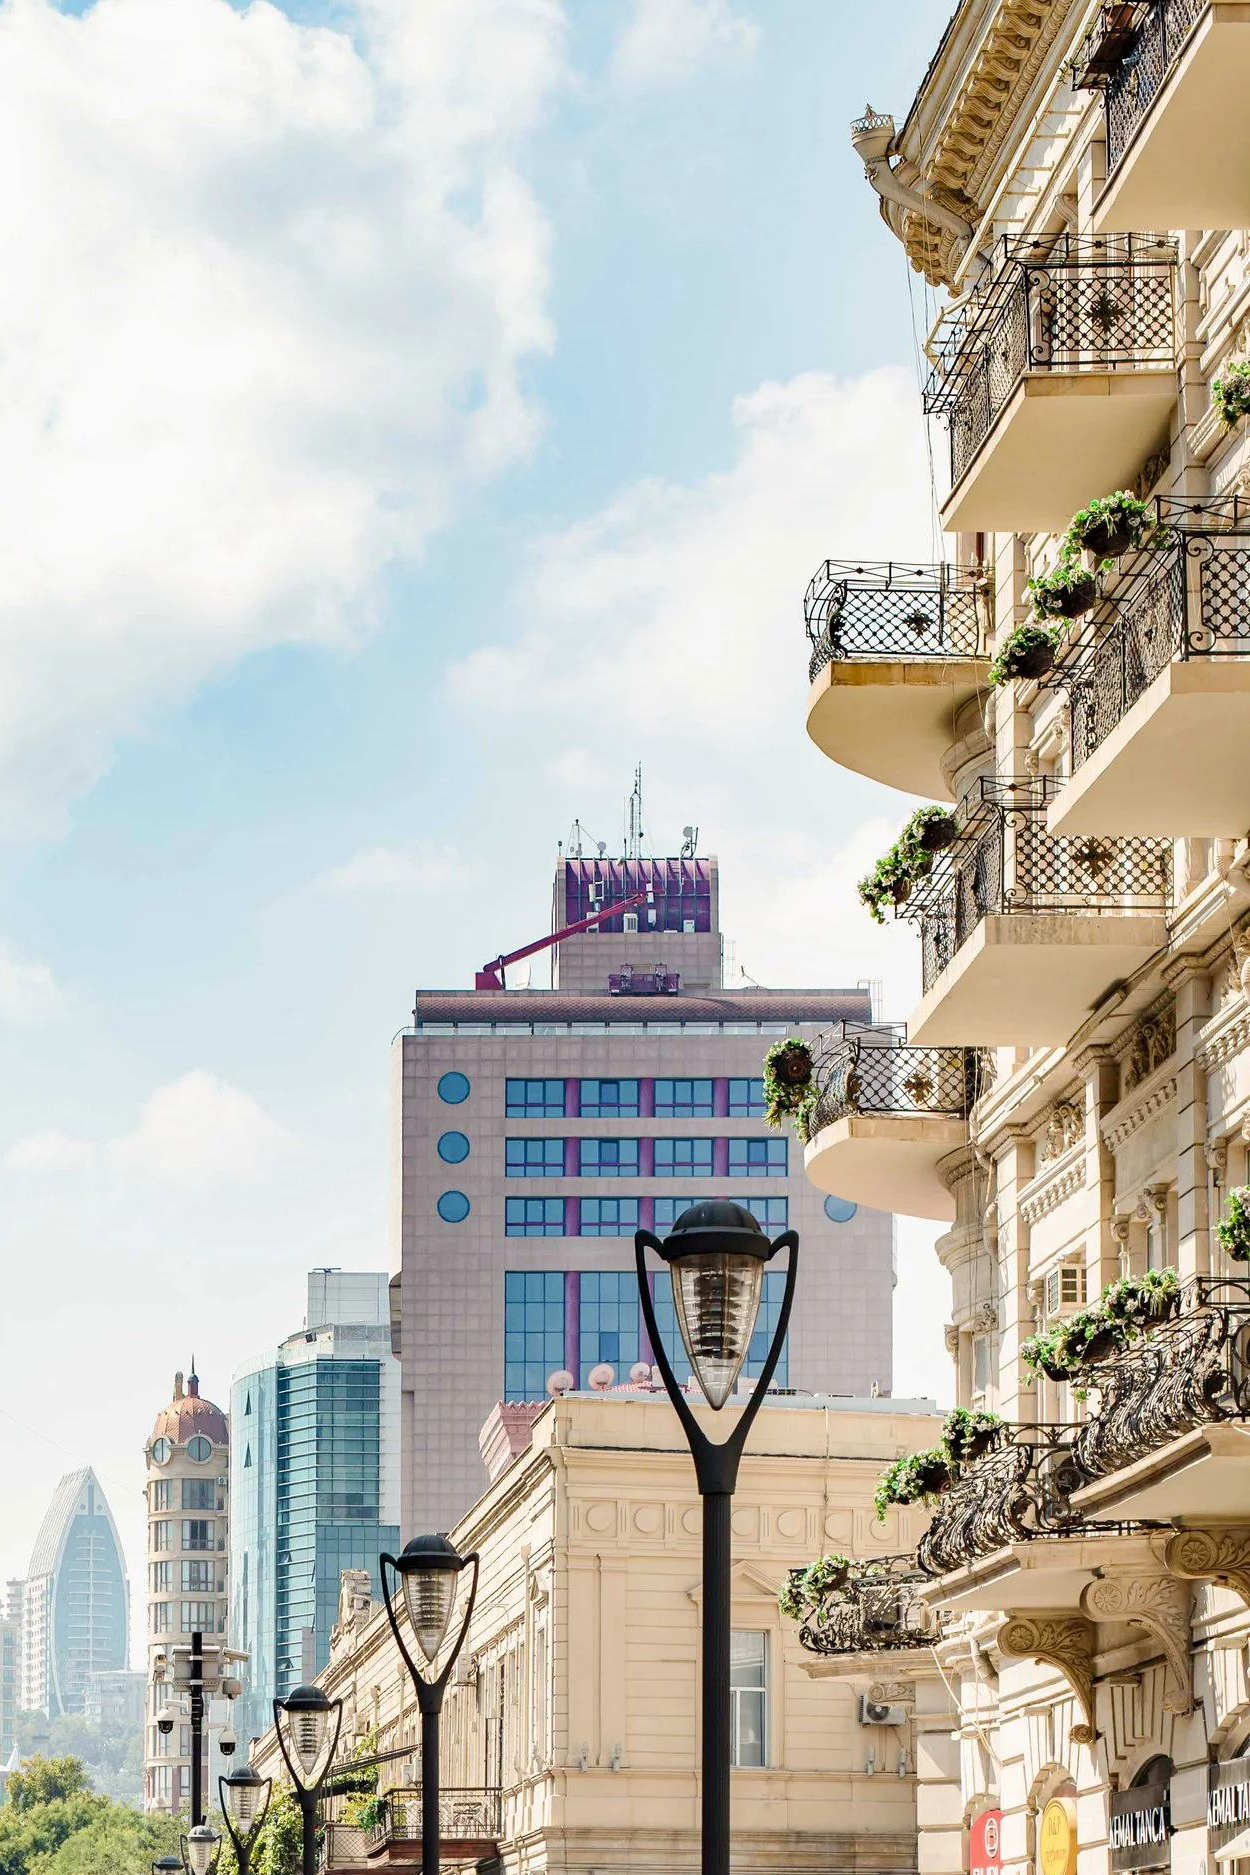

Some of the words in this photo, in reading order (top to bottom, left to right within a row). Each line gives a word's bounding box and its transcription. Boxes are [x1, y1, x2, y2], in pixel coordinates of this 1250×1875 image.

[1207, 1785, 1237, 1828] KEMAL
[1236, 1782, 1250, 1820] TA
[1110, 1812, 1136, 1849] KEMAL
[1135, 1806, 1166, 1845] TANCA
